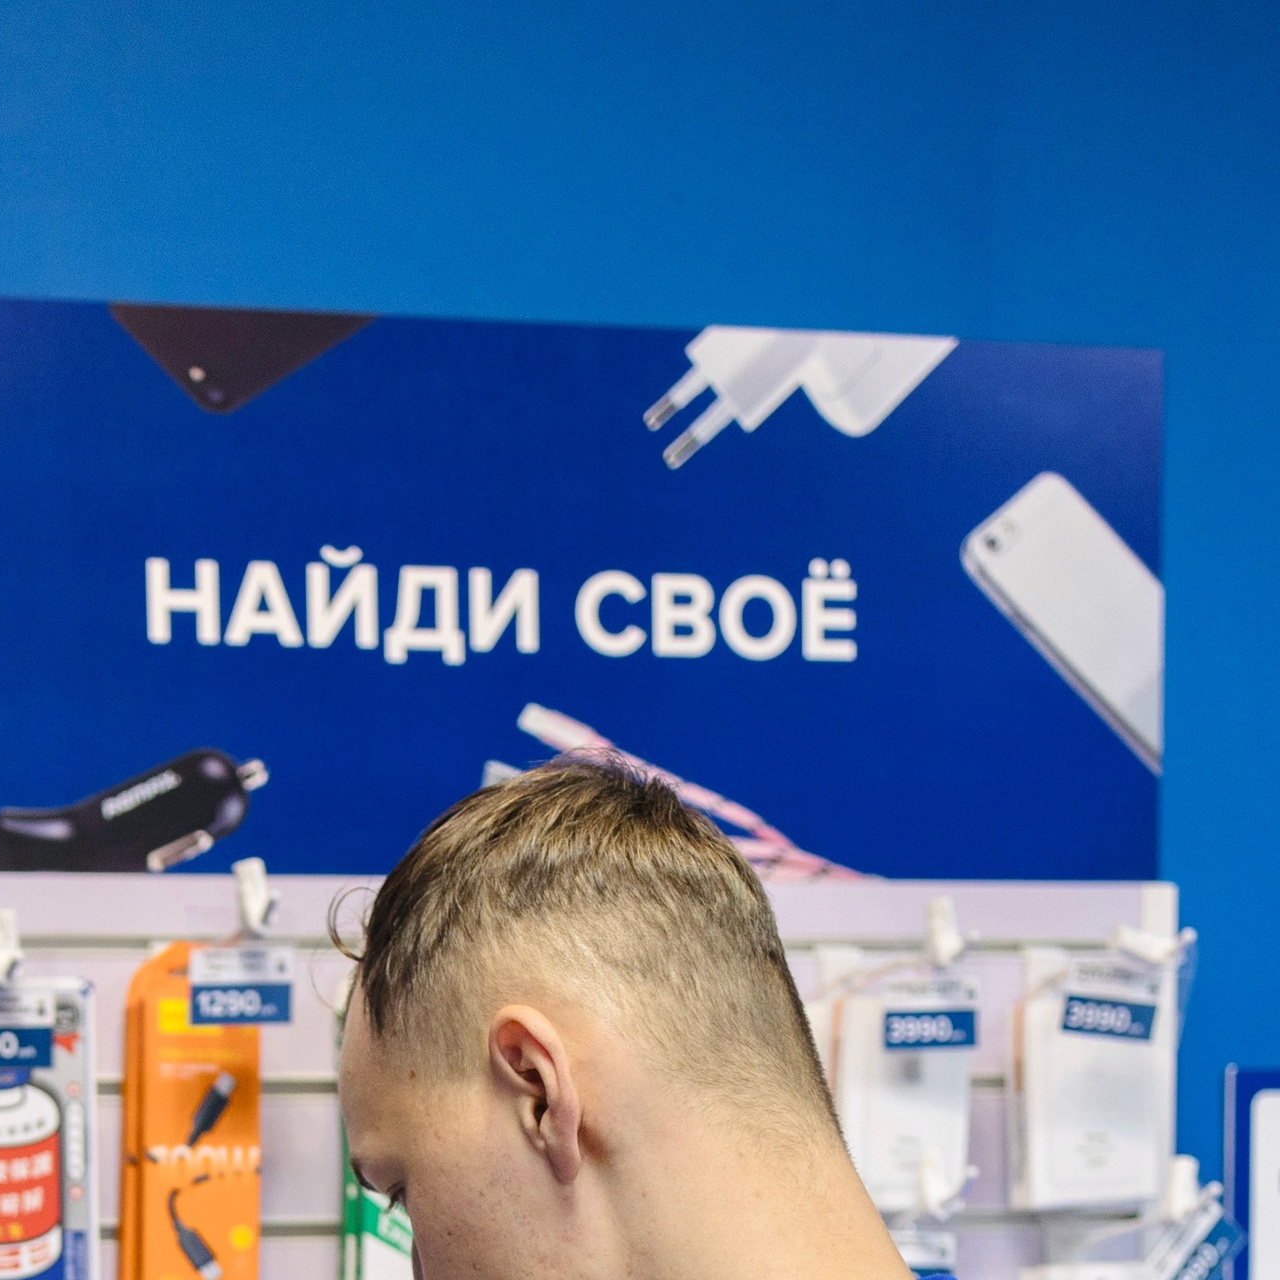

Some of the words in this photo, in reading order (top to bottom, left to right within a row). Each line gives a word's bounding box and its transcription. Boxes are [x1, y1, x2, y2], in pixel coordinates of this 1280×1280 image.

[144, 545, 540, 666] НАЙДИ
[573, 557, 858, 663] СВОЁ
[196, 989, 262, 1018] 1290
